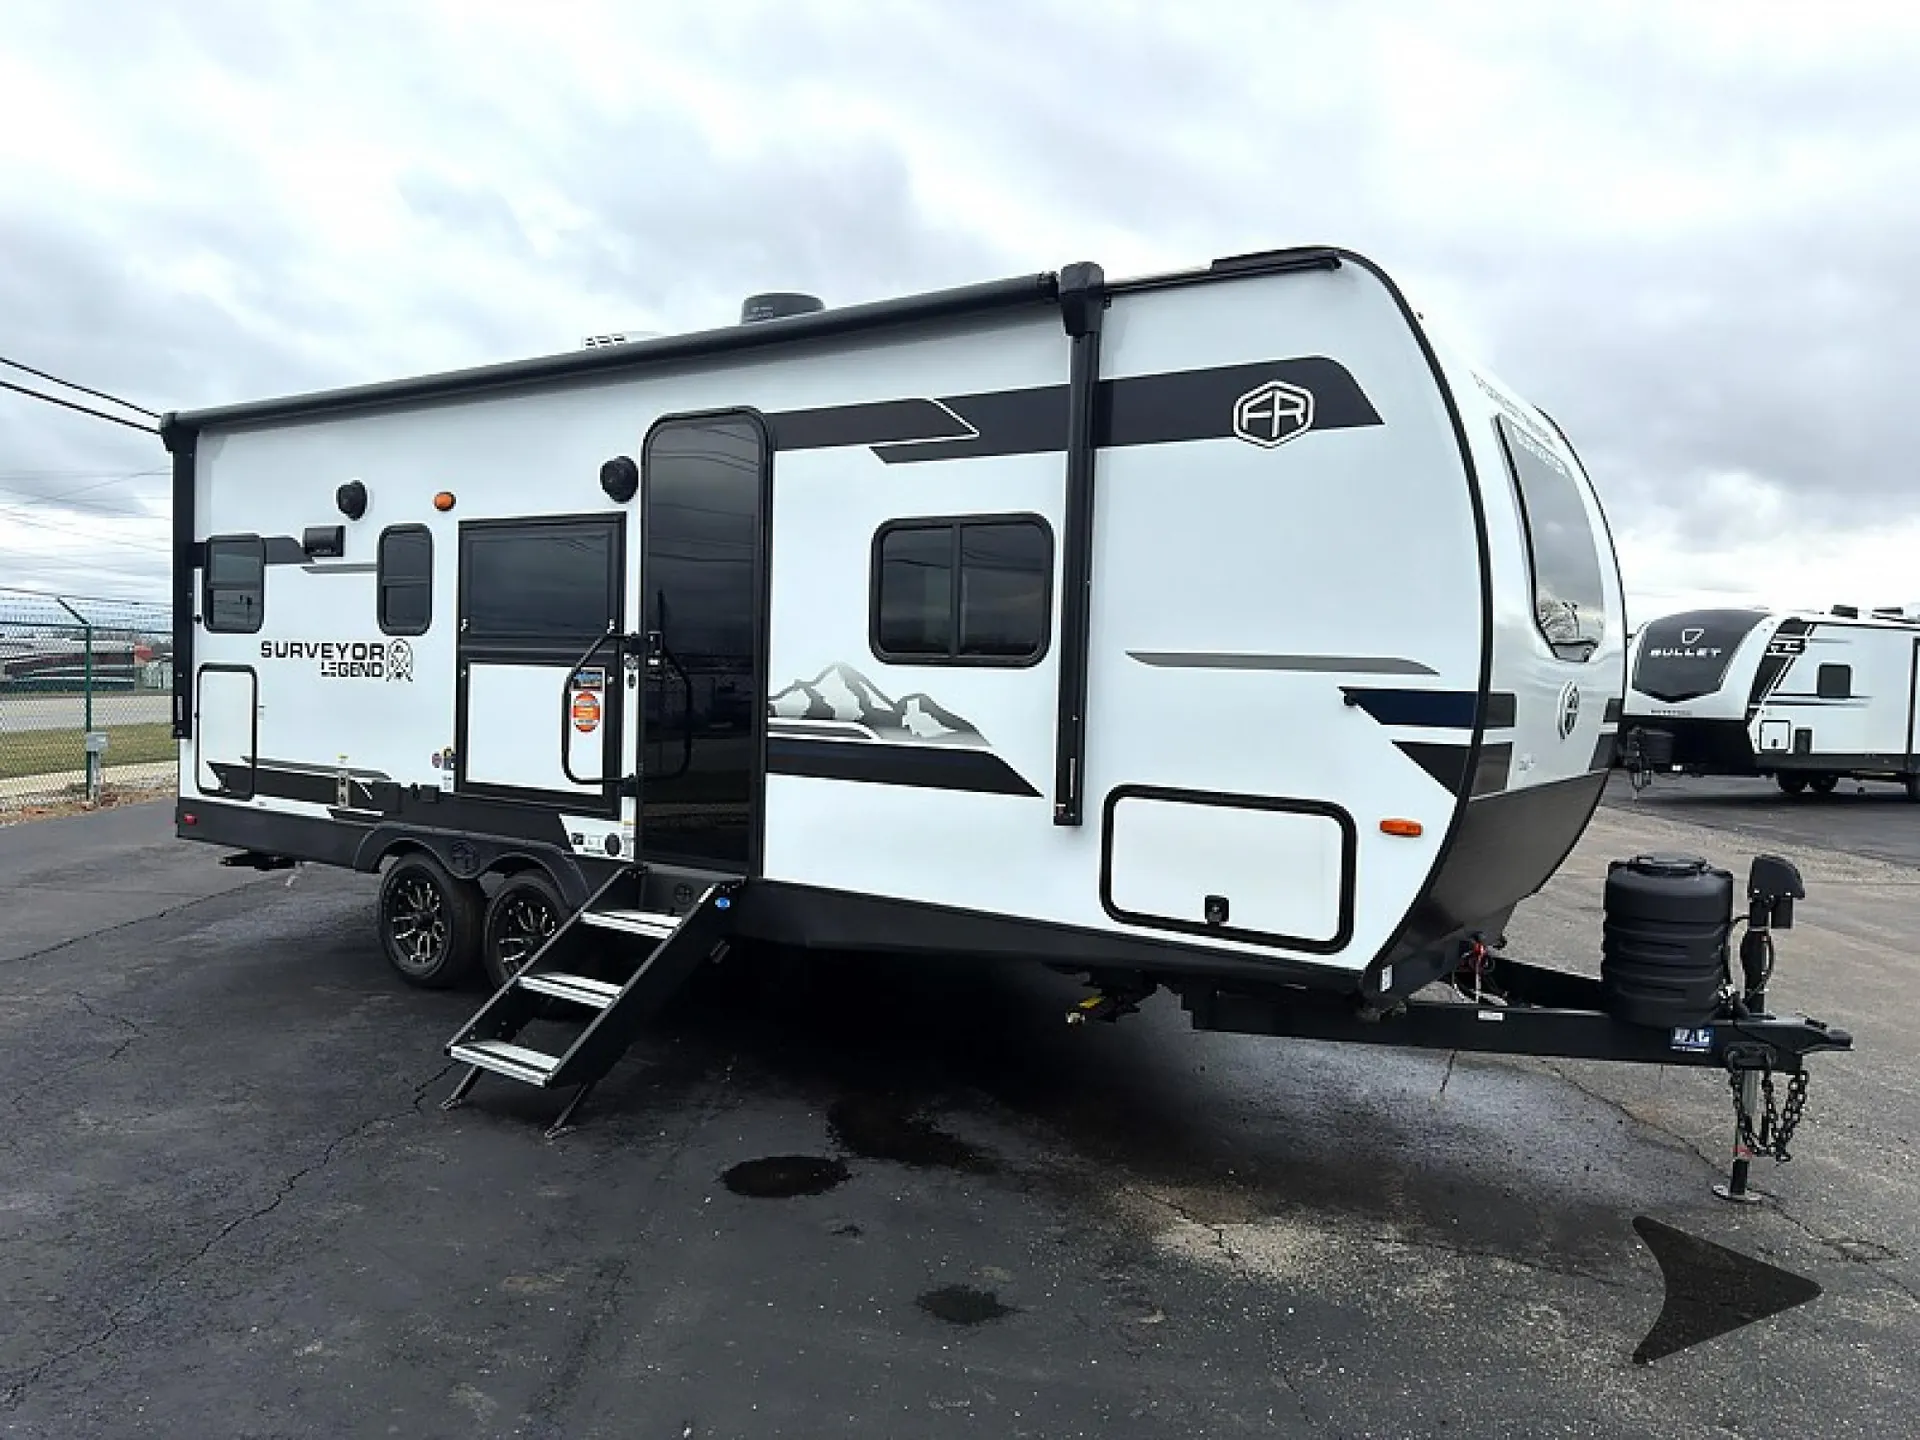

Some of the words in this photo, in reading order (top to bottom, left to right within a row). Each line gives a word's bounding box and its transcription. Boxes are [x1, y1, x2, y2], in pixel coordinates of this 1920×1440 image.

[260, 640, 385, 661] SURVEYOR
[1649, 647, 1722, 658] BULLET
[321, 661, 385, 678] LEGEND
